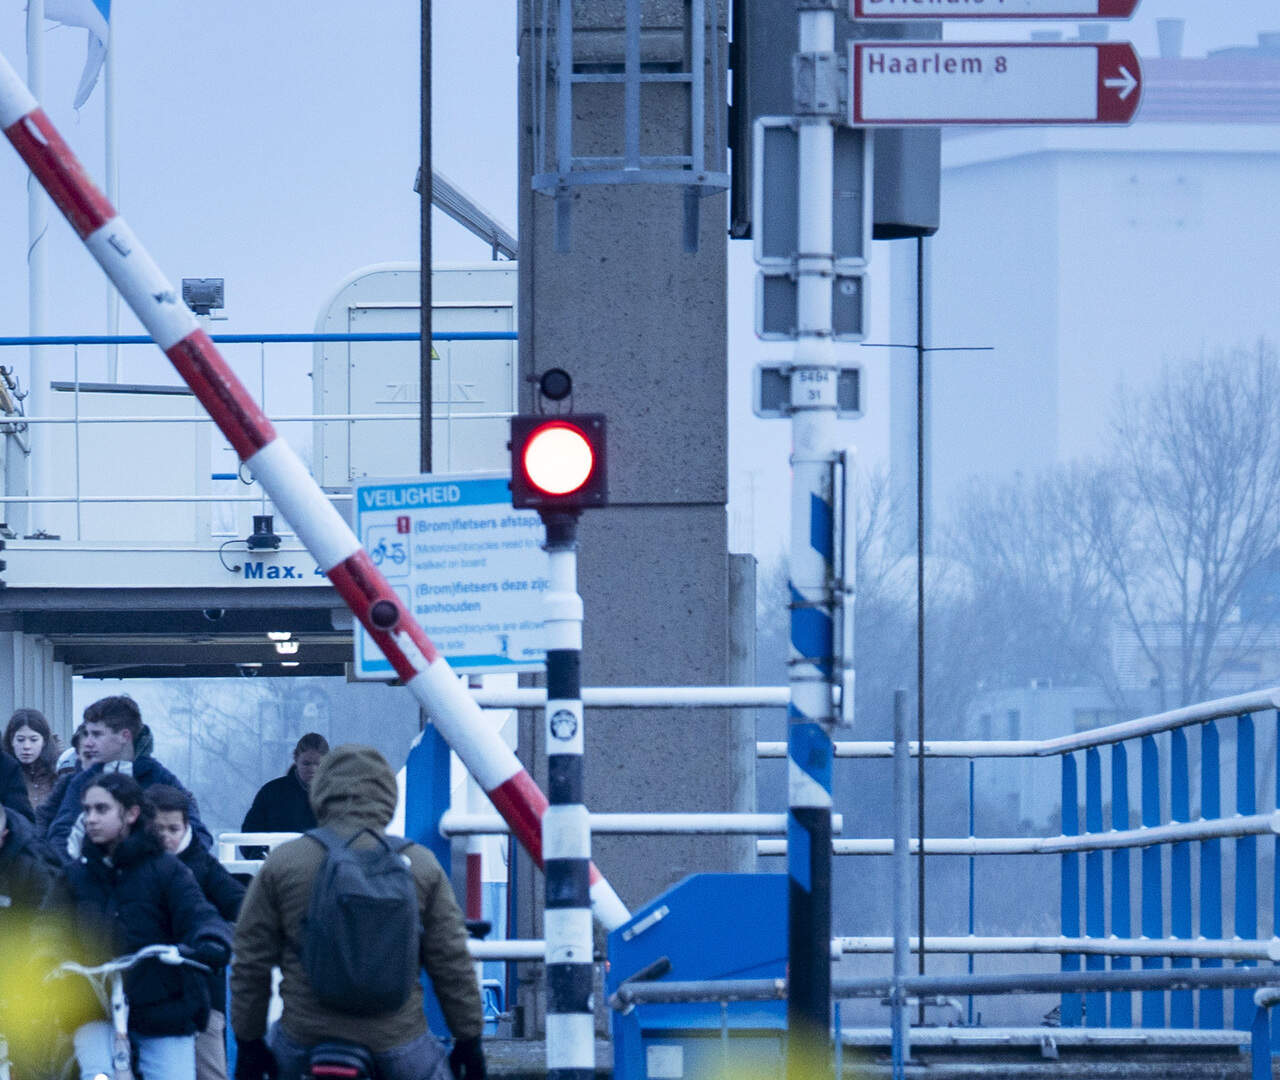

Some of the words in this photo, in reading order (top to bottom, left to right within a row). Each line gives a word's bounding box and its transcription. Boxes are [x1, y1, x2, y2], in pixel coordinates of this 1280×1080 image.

[868, 53, 983, 73] Haarlem
[995, 56, 1008, 73] 8
[363, 485, 460, 507] VEILIGHEID
[244, 562, 303, 579] Max.
[501, 580, 528, 592] deze
[416, 602, 481, 614] aanhouden
